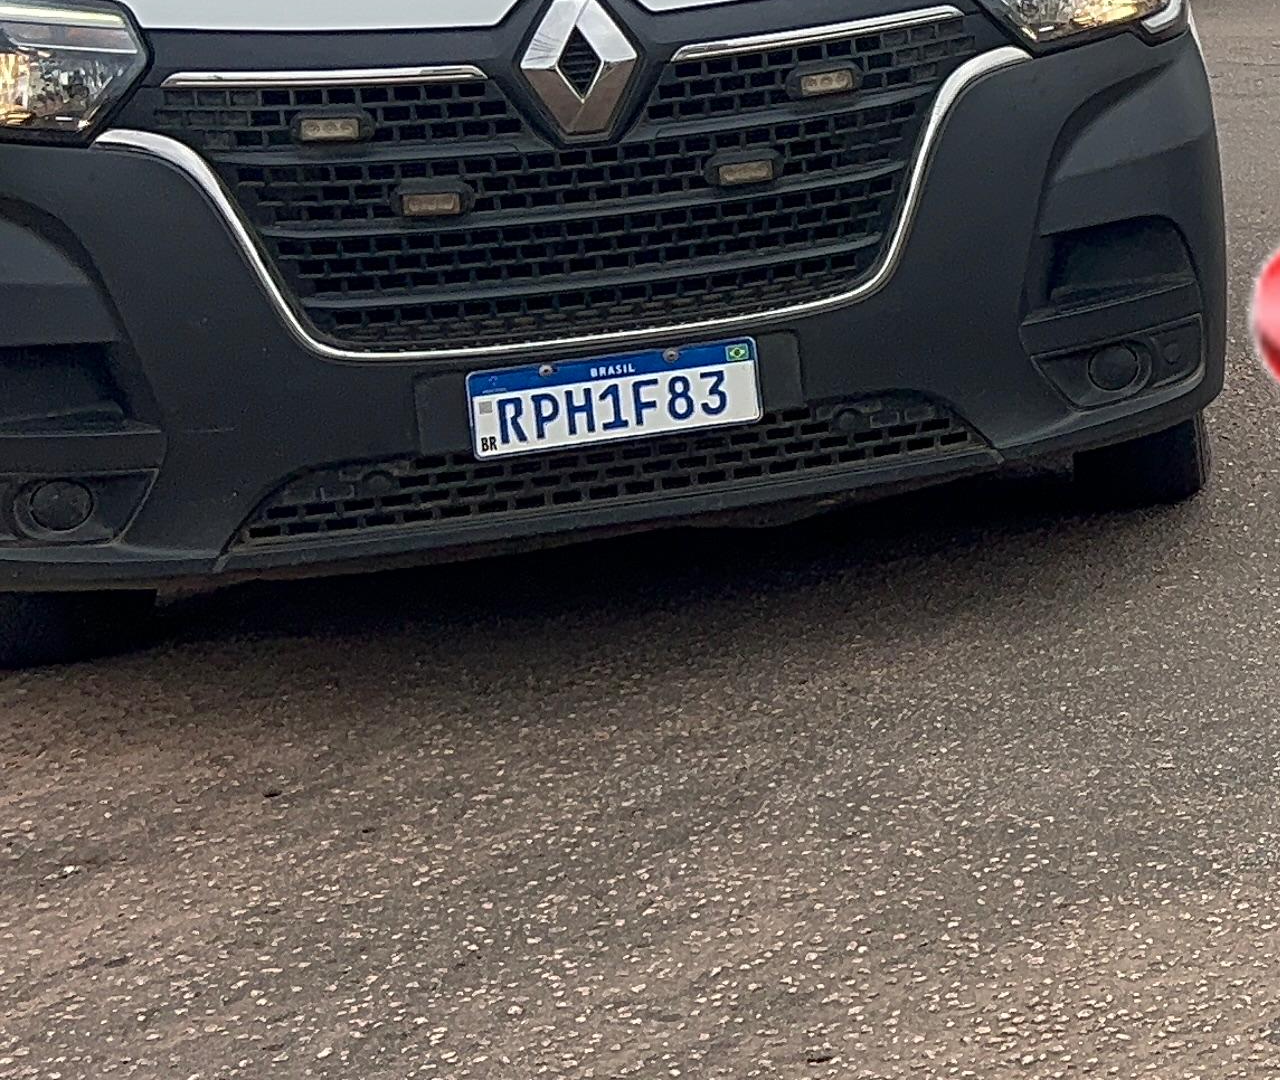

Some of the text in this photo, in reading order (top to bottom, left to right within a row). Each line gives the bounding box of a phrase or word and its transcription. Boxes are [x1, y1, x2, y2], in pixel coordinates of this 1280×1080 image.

[590, 363, 635, 378] BRASIL
[497, 370, 727, 445] RPH1F83
[481, 436, 498, 452] BR
